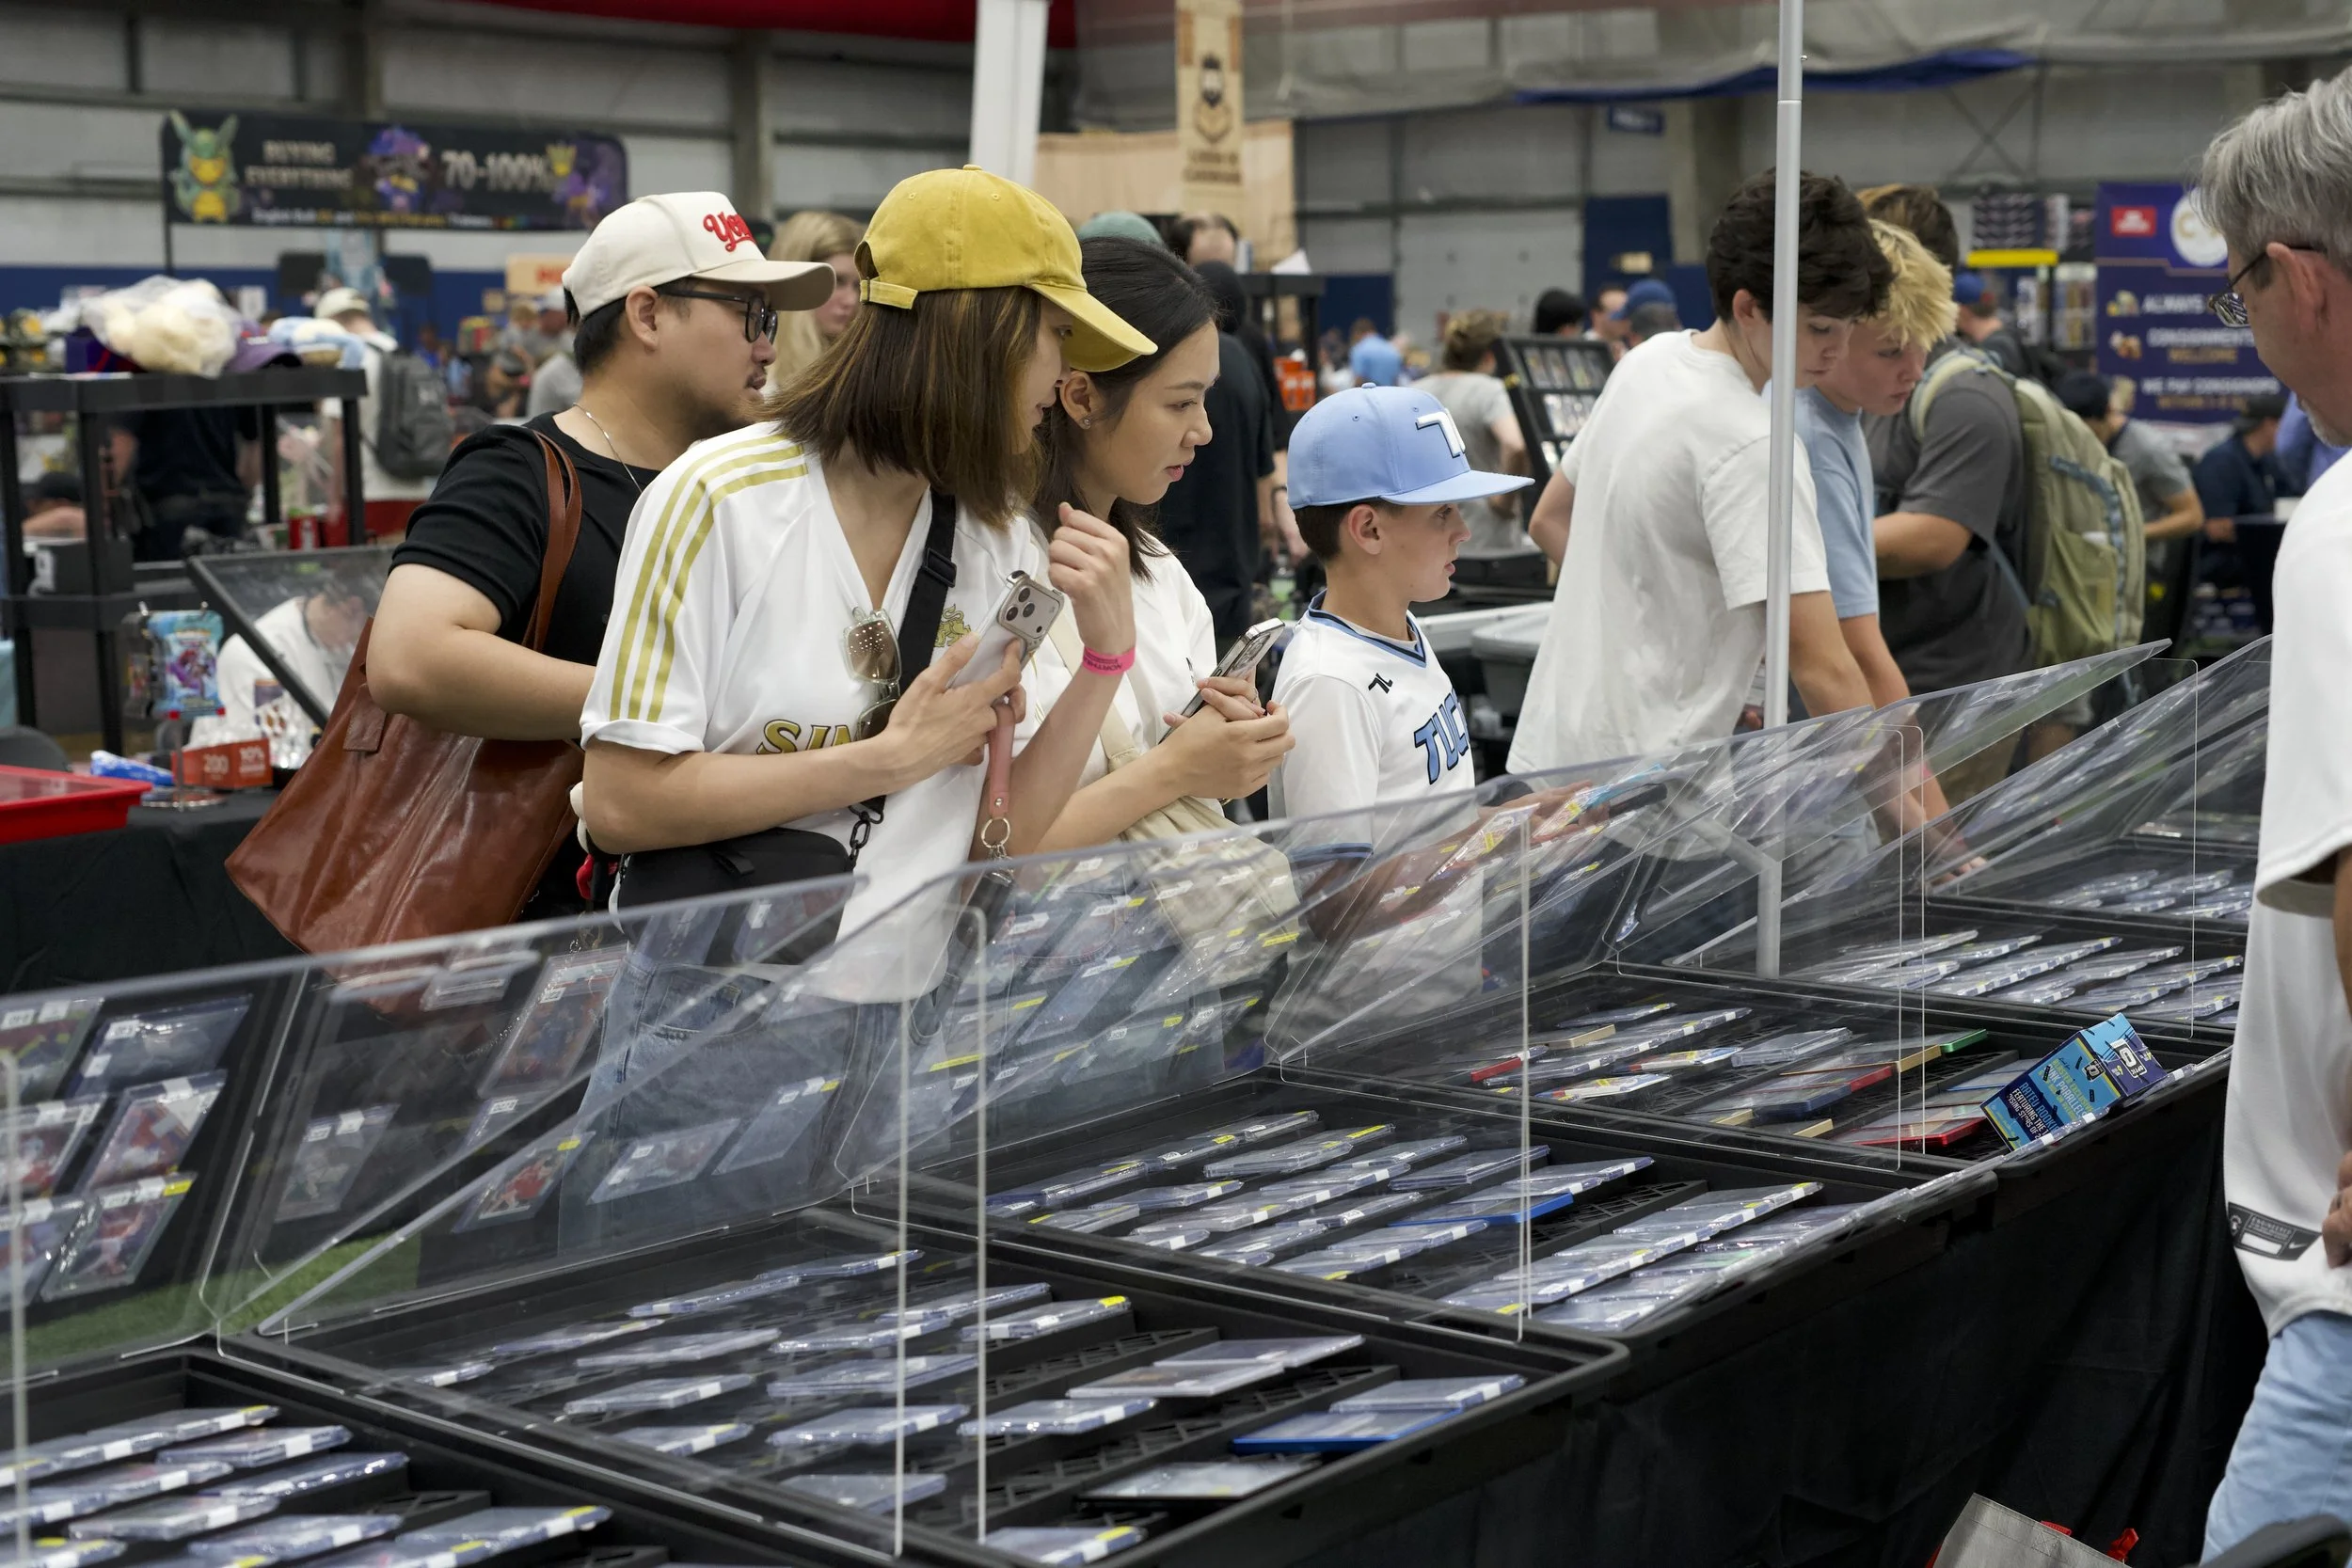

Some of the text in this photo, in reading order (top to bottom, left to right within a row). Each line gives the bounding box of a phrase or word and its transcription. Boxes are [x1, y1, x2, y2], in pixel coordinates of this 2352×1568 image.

[2142, 293, 2204, 314] ALWAYS
[2011, 1088, 2039, 1120] FEATURING
[2033, 1118, 2046, 1132] THE
[2029, 1126, 2039, 1135] OF
